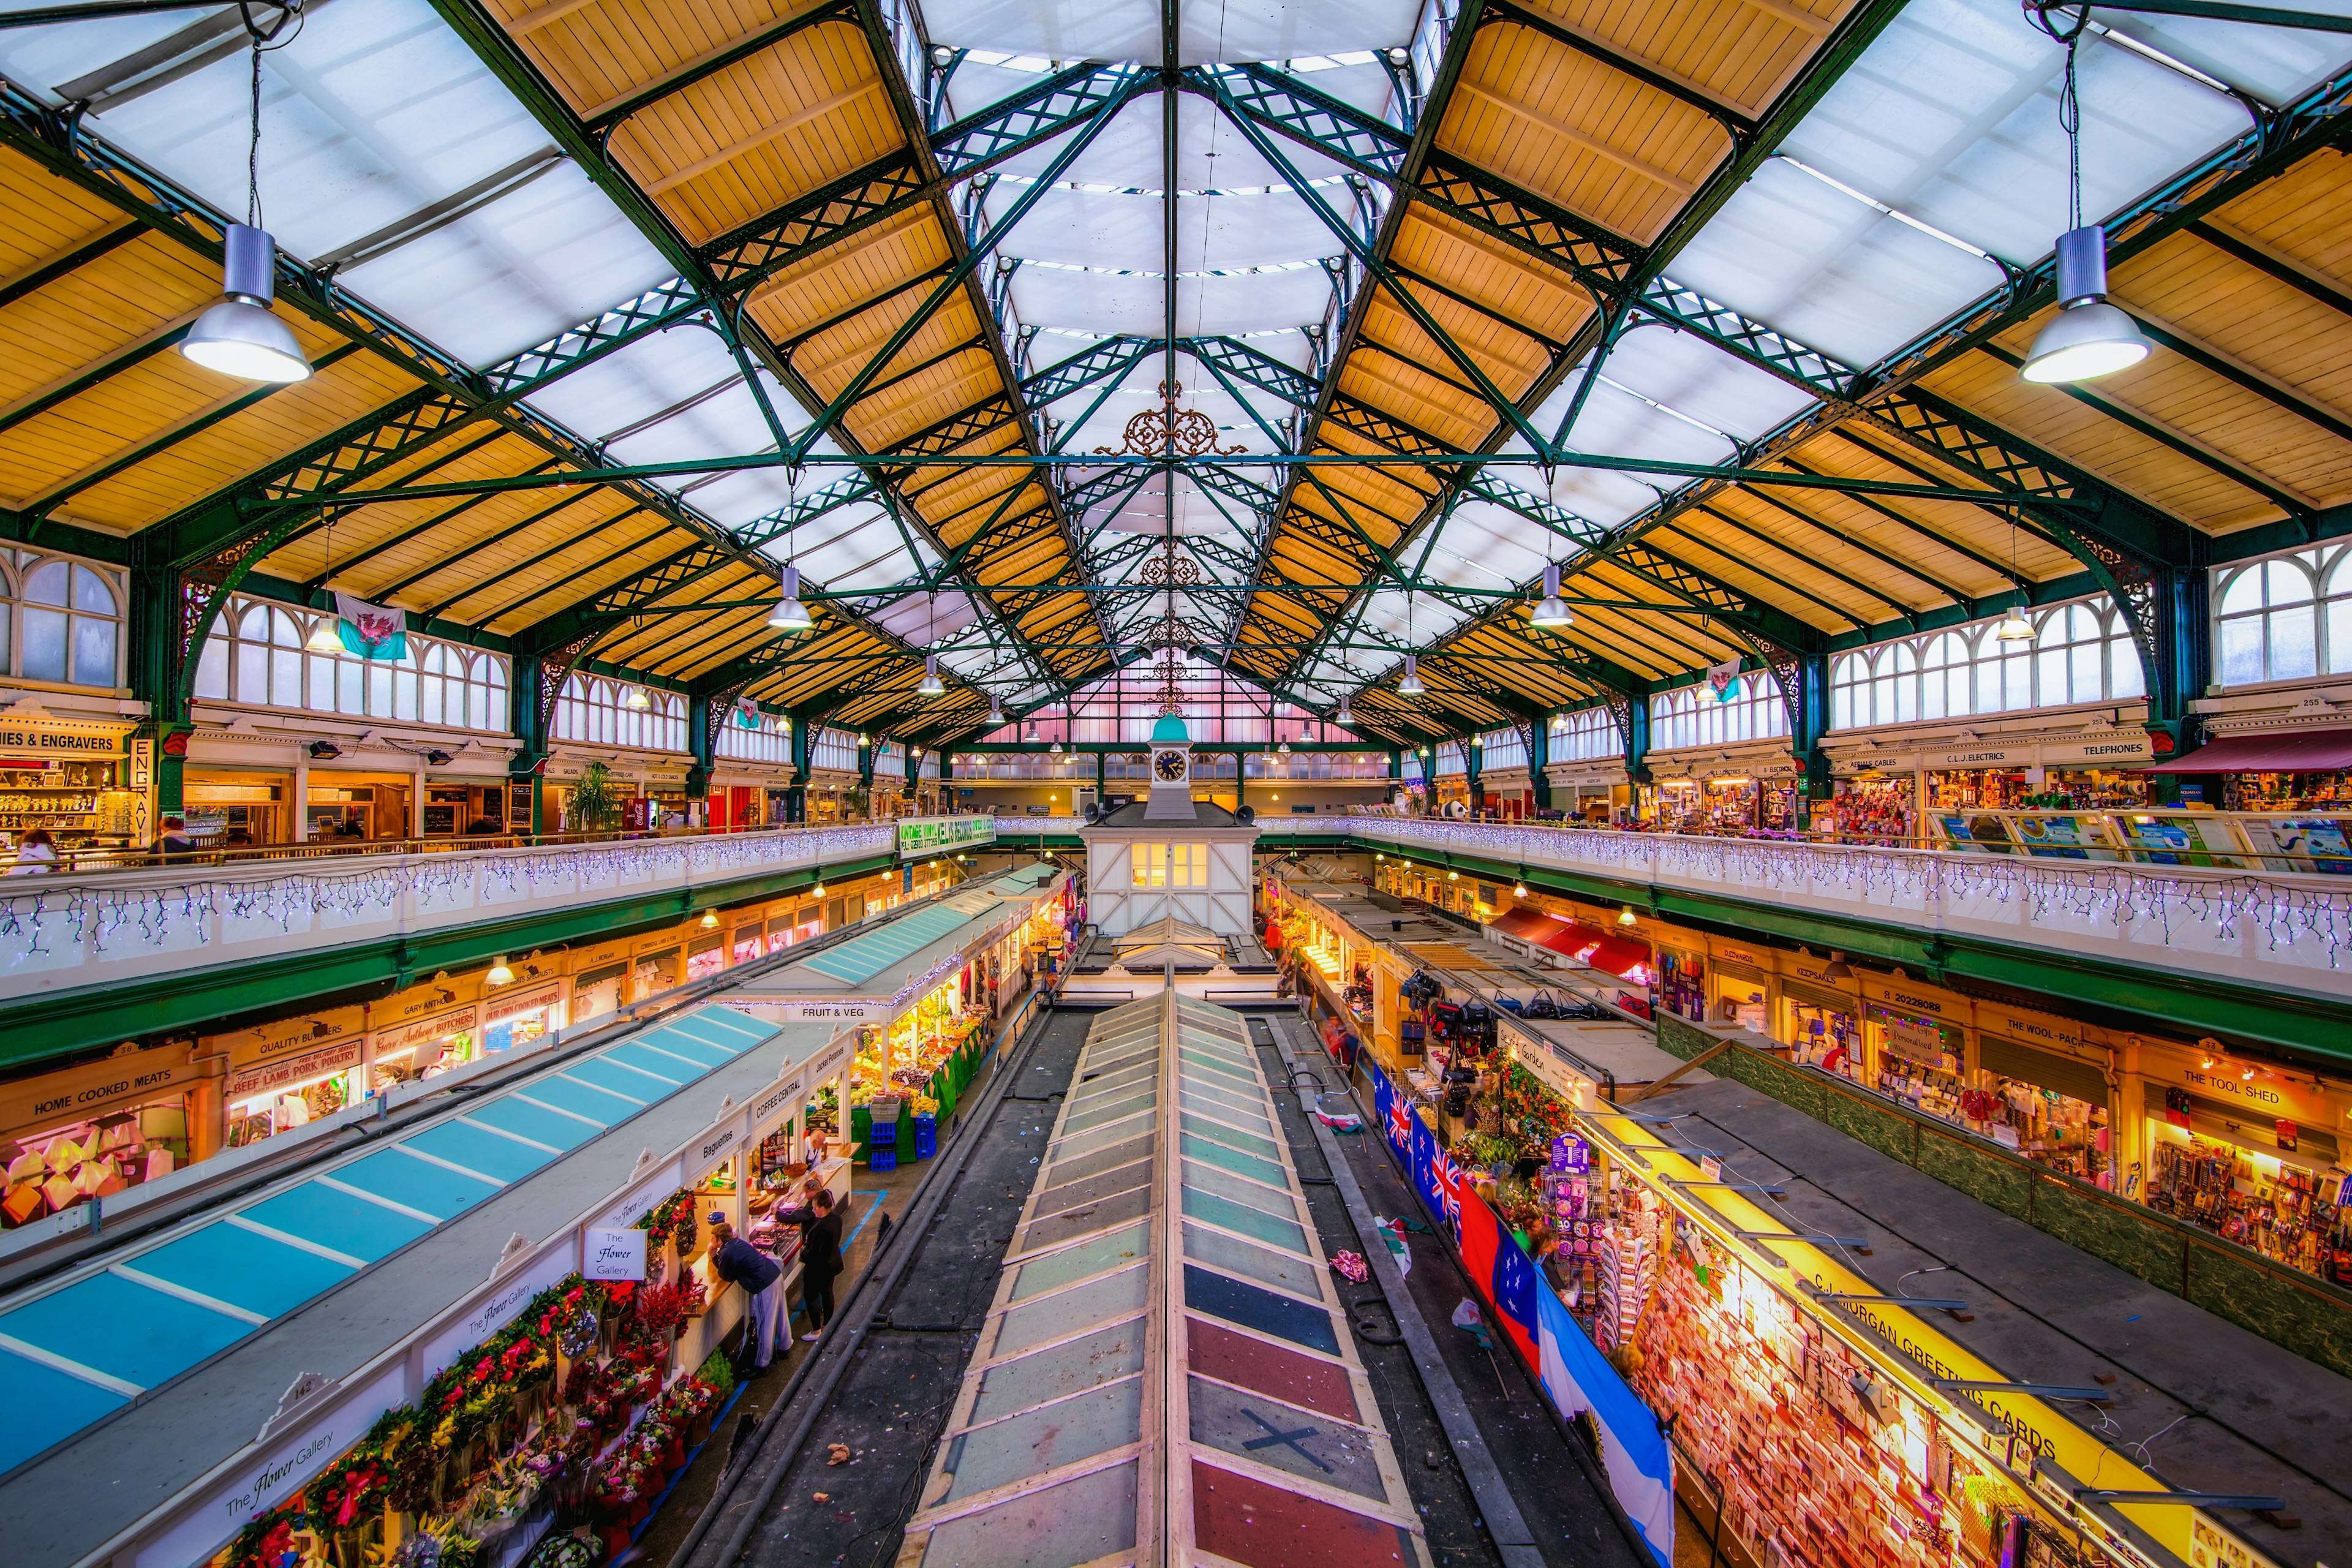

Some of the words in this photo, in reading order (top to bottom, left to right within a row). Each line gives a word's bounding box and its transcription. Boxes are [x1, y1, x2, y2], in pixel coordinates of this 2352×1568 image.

[2304, 698, 2320, 707] 255
[28, 734, 37, 746] &
[42, 735, 113, 750] ENGRAVERS
[2082, 743, 2143, 756] TELEPHONES
[1874, 758, 1896, 767] CABLES
[923, 823, 937, 837] VINYL
[911, 839, 923, 850] 02920
[1796, 967, 1836, 985] KEEPSAKES
[404, 1003, 423, 1016] GARY
[486, 1009, 500, 1022] OUR
[500, 1005, 514, 1017] OWN
[514, 997, 539, 1014] COOKED
[539, 991, 558, 1005] MEATS
[1895, 993, 1941, 1012] 20228088
[844, 1008, 865, 1017] VEG
[376, 1036, 398, 1056] Gary
[399, 1024, 436, 1046] Anthony
[435, 1013, 474, 1033] BUTCHERS
[1891, 1029, 1932, 1050] Personalised
[1917, 1025, 1933, 1037] Gifts
[2007, 1019, 2024, 1031] THE
[2026, 1025, 2086, 1049] WOOL-PACK
[121, 1045, 132, 1054] 36
[260, 1036, 300, 1054] QUALITY
[1893, 1043, 1907, 1055] While
[2205, 1041, 2215, 1050] 33
[298, 1055, 312, 1065] FREE
[313, 1048, 337, 1061] DELIVERY
[816, 1056, 829, 1073] Jacket
[828, 1047, 844, 1064] Potatoes
[1521, 1044, 1546, 1073] Garden
[235, 1077, 260, 1095] BEEF
[264, 1068, 290, 1086] LAMB
[293, 1061, 318, 1077] PORK
[322, 1049, 356, 1069] POULTRY
[34, 1095, 72, 1115] HOME
[78, 1080, 129, 1103] COOKED
[134, 1069, 172, 1088] MEATS
[2183, 1069, 2206, 1085] THE
[2209, 1076, 2242, 1095] TOOL
[2245, 1085, 2280, 1105] SHED
[756, 1095, 778, 1120] COFFEE
[778, 1079, 801, 1101] CENTRAL
[703, 1130, 733, 1159] Baguettes
[1702, 1157, 1720, 1170] FRAGILE
[1704, 1167, 1716, 1178] ROOF
[611, 1214, 622, 1227] The
[620, 1200, 638, 1226] Flower
[637, 1191, 653, 1211] Gallery
[510, 1239, 522, 1254] 140
[605, 1233, 624, 1242] The
[596, 1245, 631, 1263] Flower
[597, 1265, 630, 1277] Gallery
[469, 1319, 483, 1335] The
[482, 1298, 508, 1333] Flower
[508, 1282, 531, 1305] Gallery
[294, 1381, 312, 1401] 142
[1989, 1400, 2056, 1461] CARDS
[225, 1493, 251, 1517] The
[249, 1458, 294, 1511] Flower
[296, 1431, 334, 1465] Gallery
